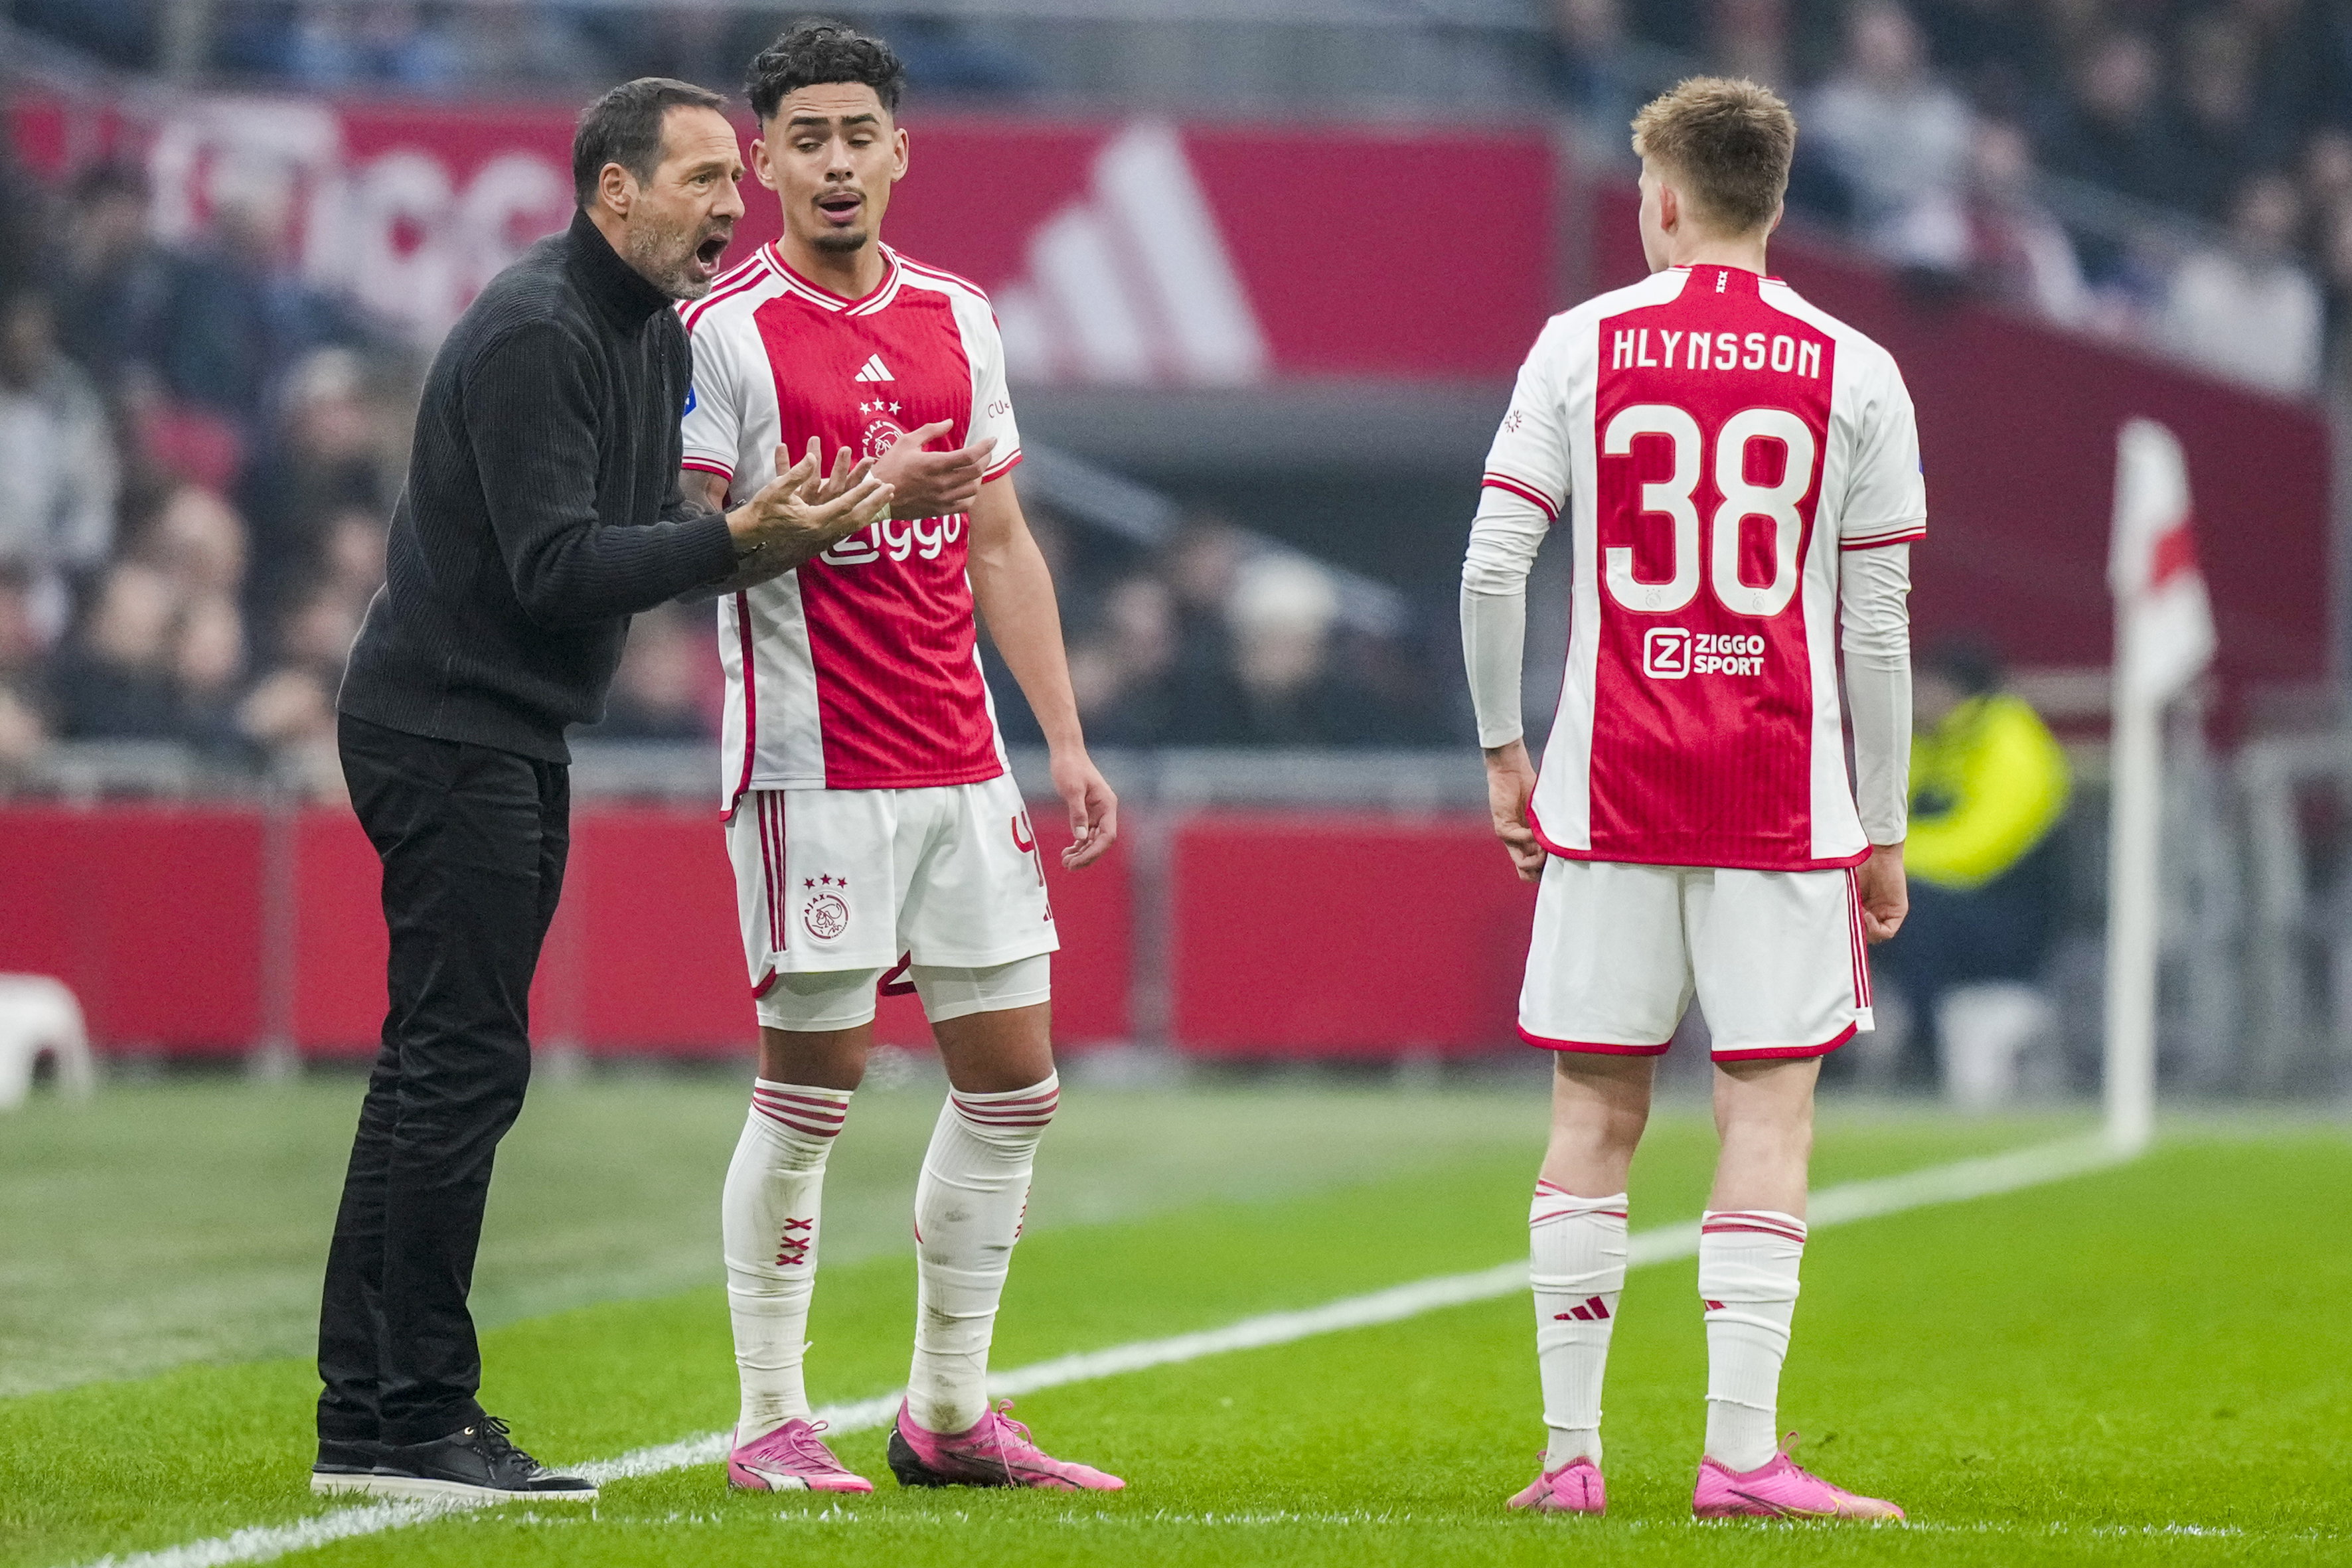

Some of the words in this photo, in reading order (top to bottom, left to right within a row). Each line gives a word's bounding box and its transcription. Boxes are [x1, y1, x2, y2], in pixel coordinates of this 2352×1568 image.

[1612, 329, 1822, 379] HLYNSSON
[862, 420, 883, 446] AJAX
[1603, 403, 1816, 617] 38
[1695, 633, 1765, 655] ZIGGO
[1693, 655, 1764, 676] SPORT
[804, 894, 825, 915] AJAX
